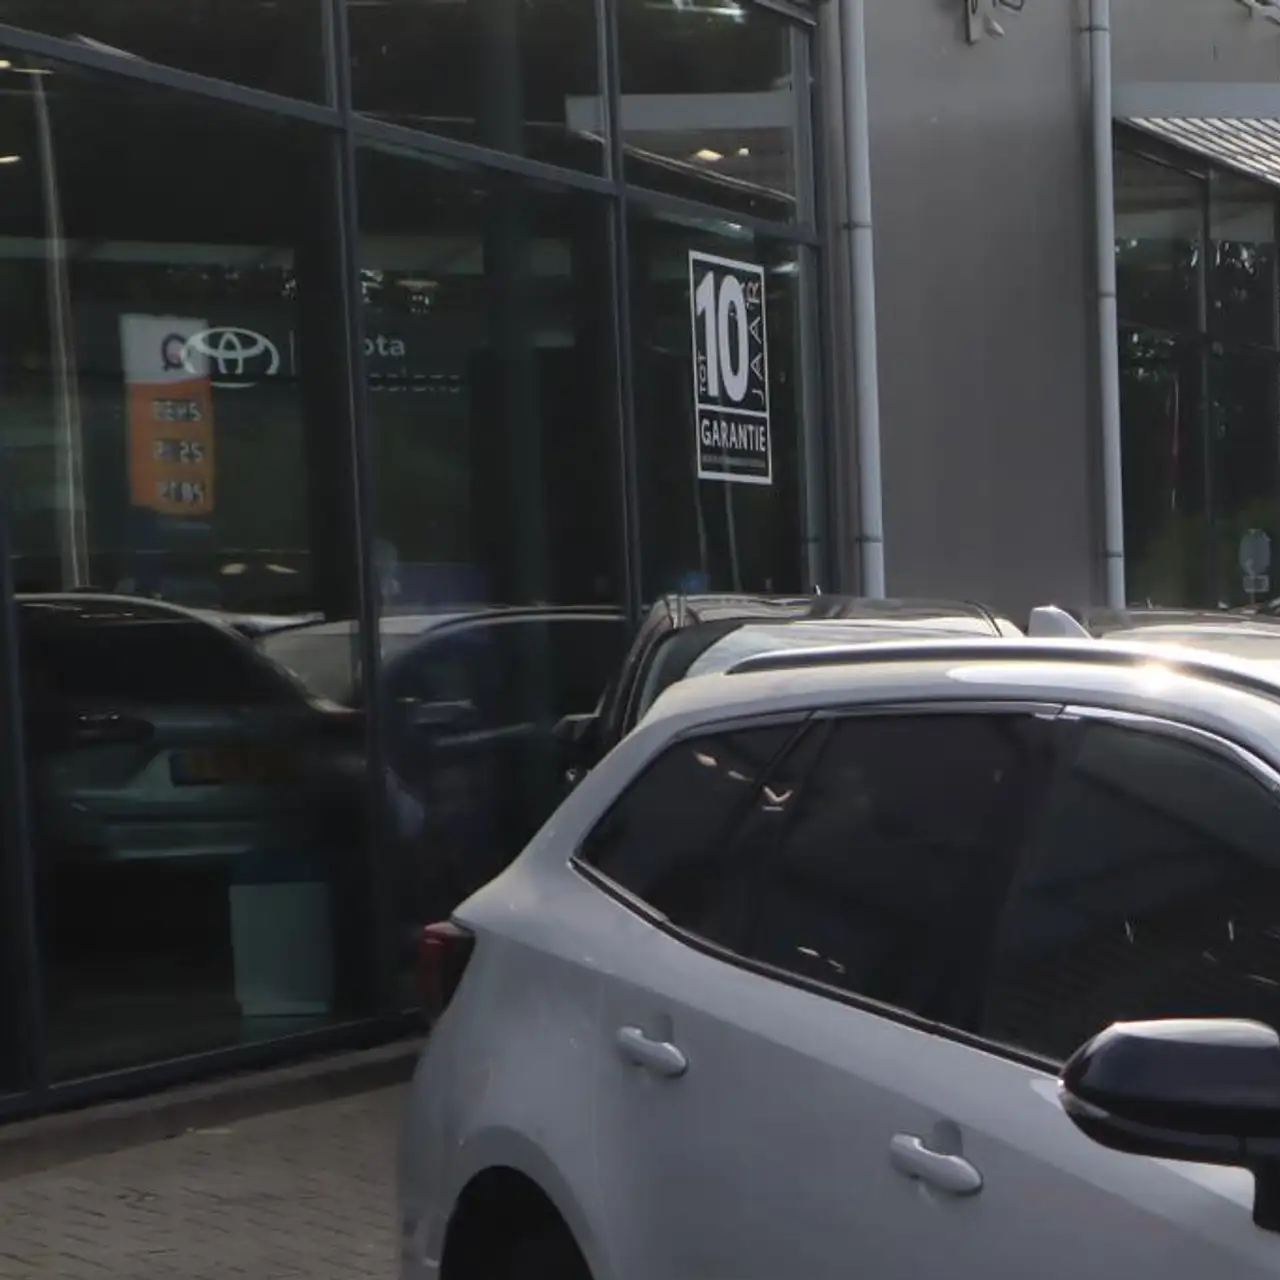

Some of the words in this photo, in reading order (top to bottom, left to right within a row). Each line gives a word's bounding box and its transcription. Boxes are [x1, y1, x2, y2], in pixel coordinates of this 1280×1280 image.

[696, 271, 749, 402] 10
[698, 352, 707, 395] TOT
[746, 281, 765, 405] JAAR
[702, 419, 766, 452] GARANTIE
